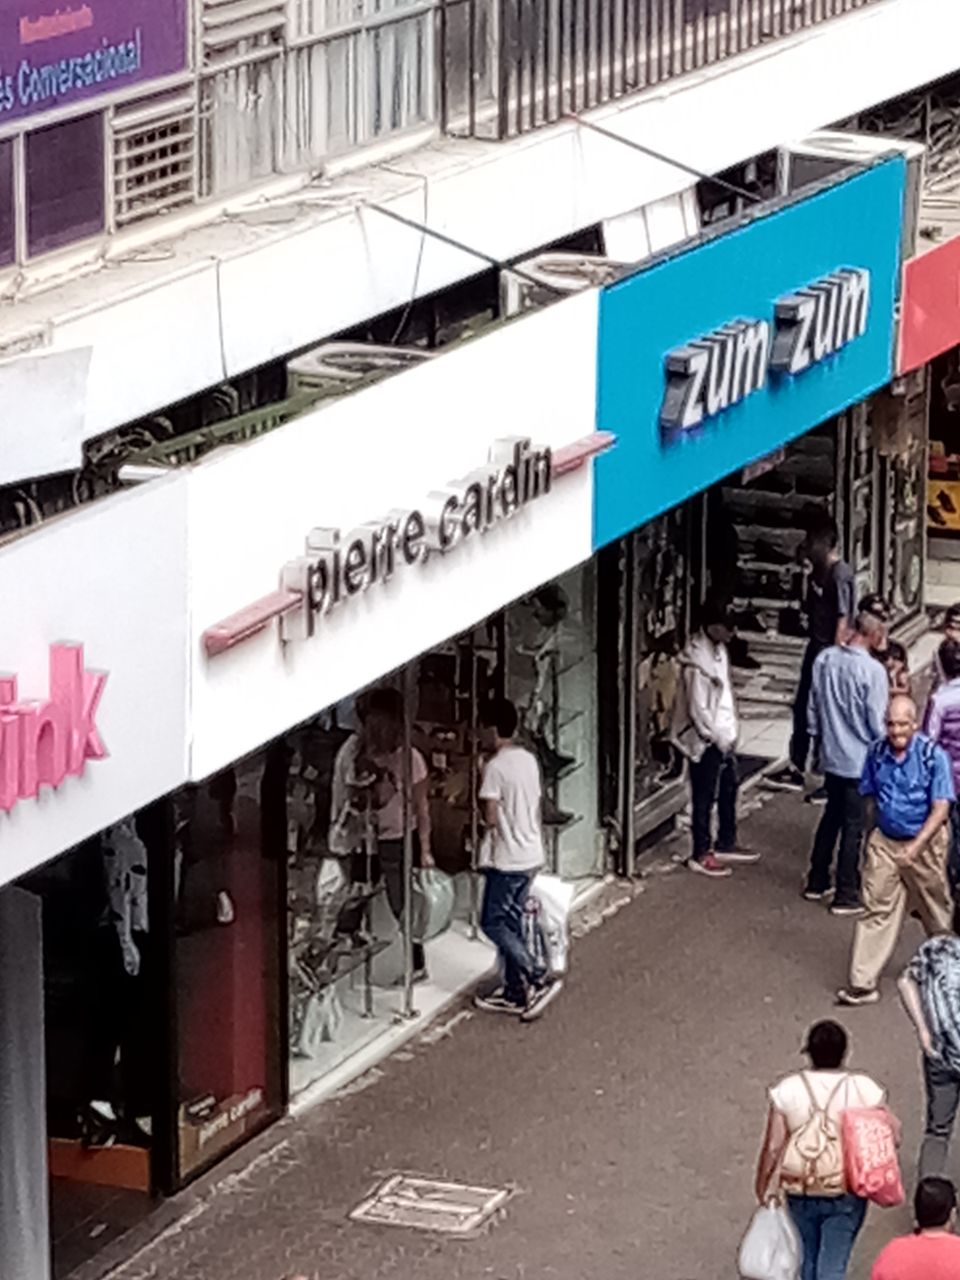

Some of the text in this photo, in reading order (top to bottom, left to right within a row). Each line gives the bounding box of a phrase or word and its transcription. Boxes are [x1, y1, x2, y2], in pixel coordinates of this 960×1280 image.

[18, 27, 142, 105] Conversacional
[668, 266, 871, 429] zum zum
[295, 437, 552, 638] pierre cardin
